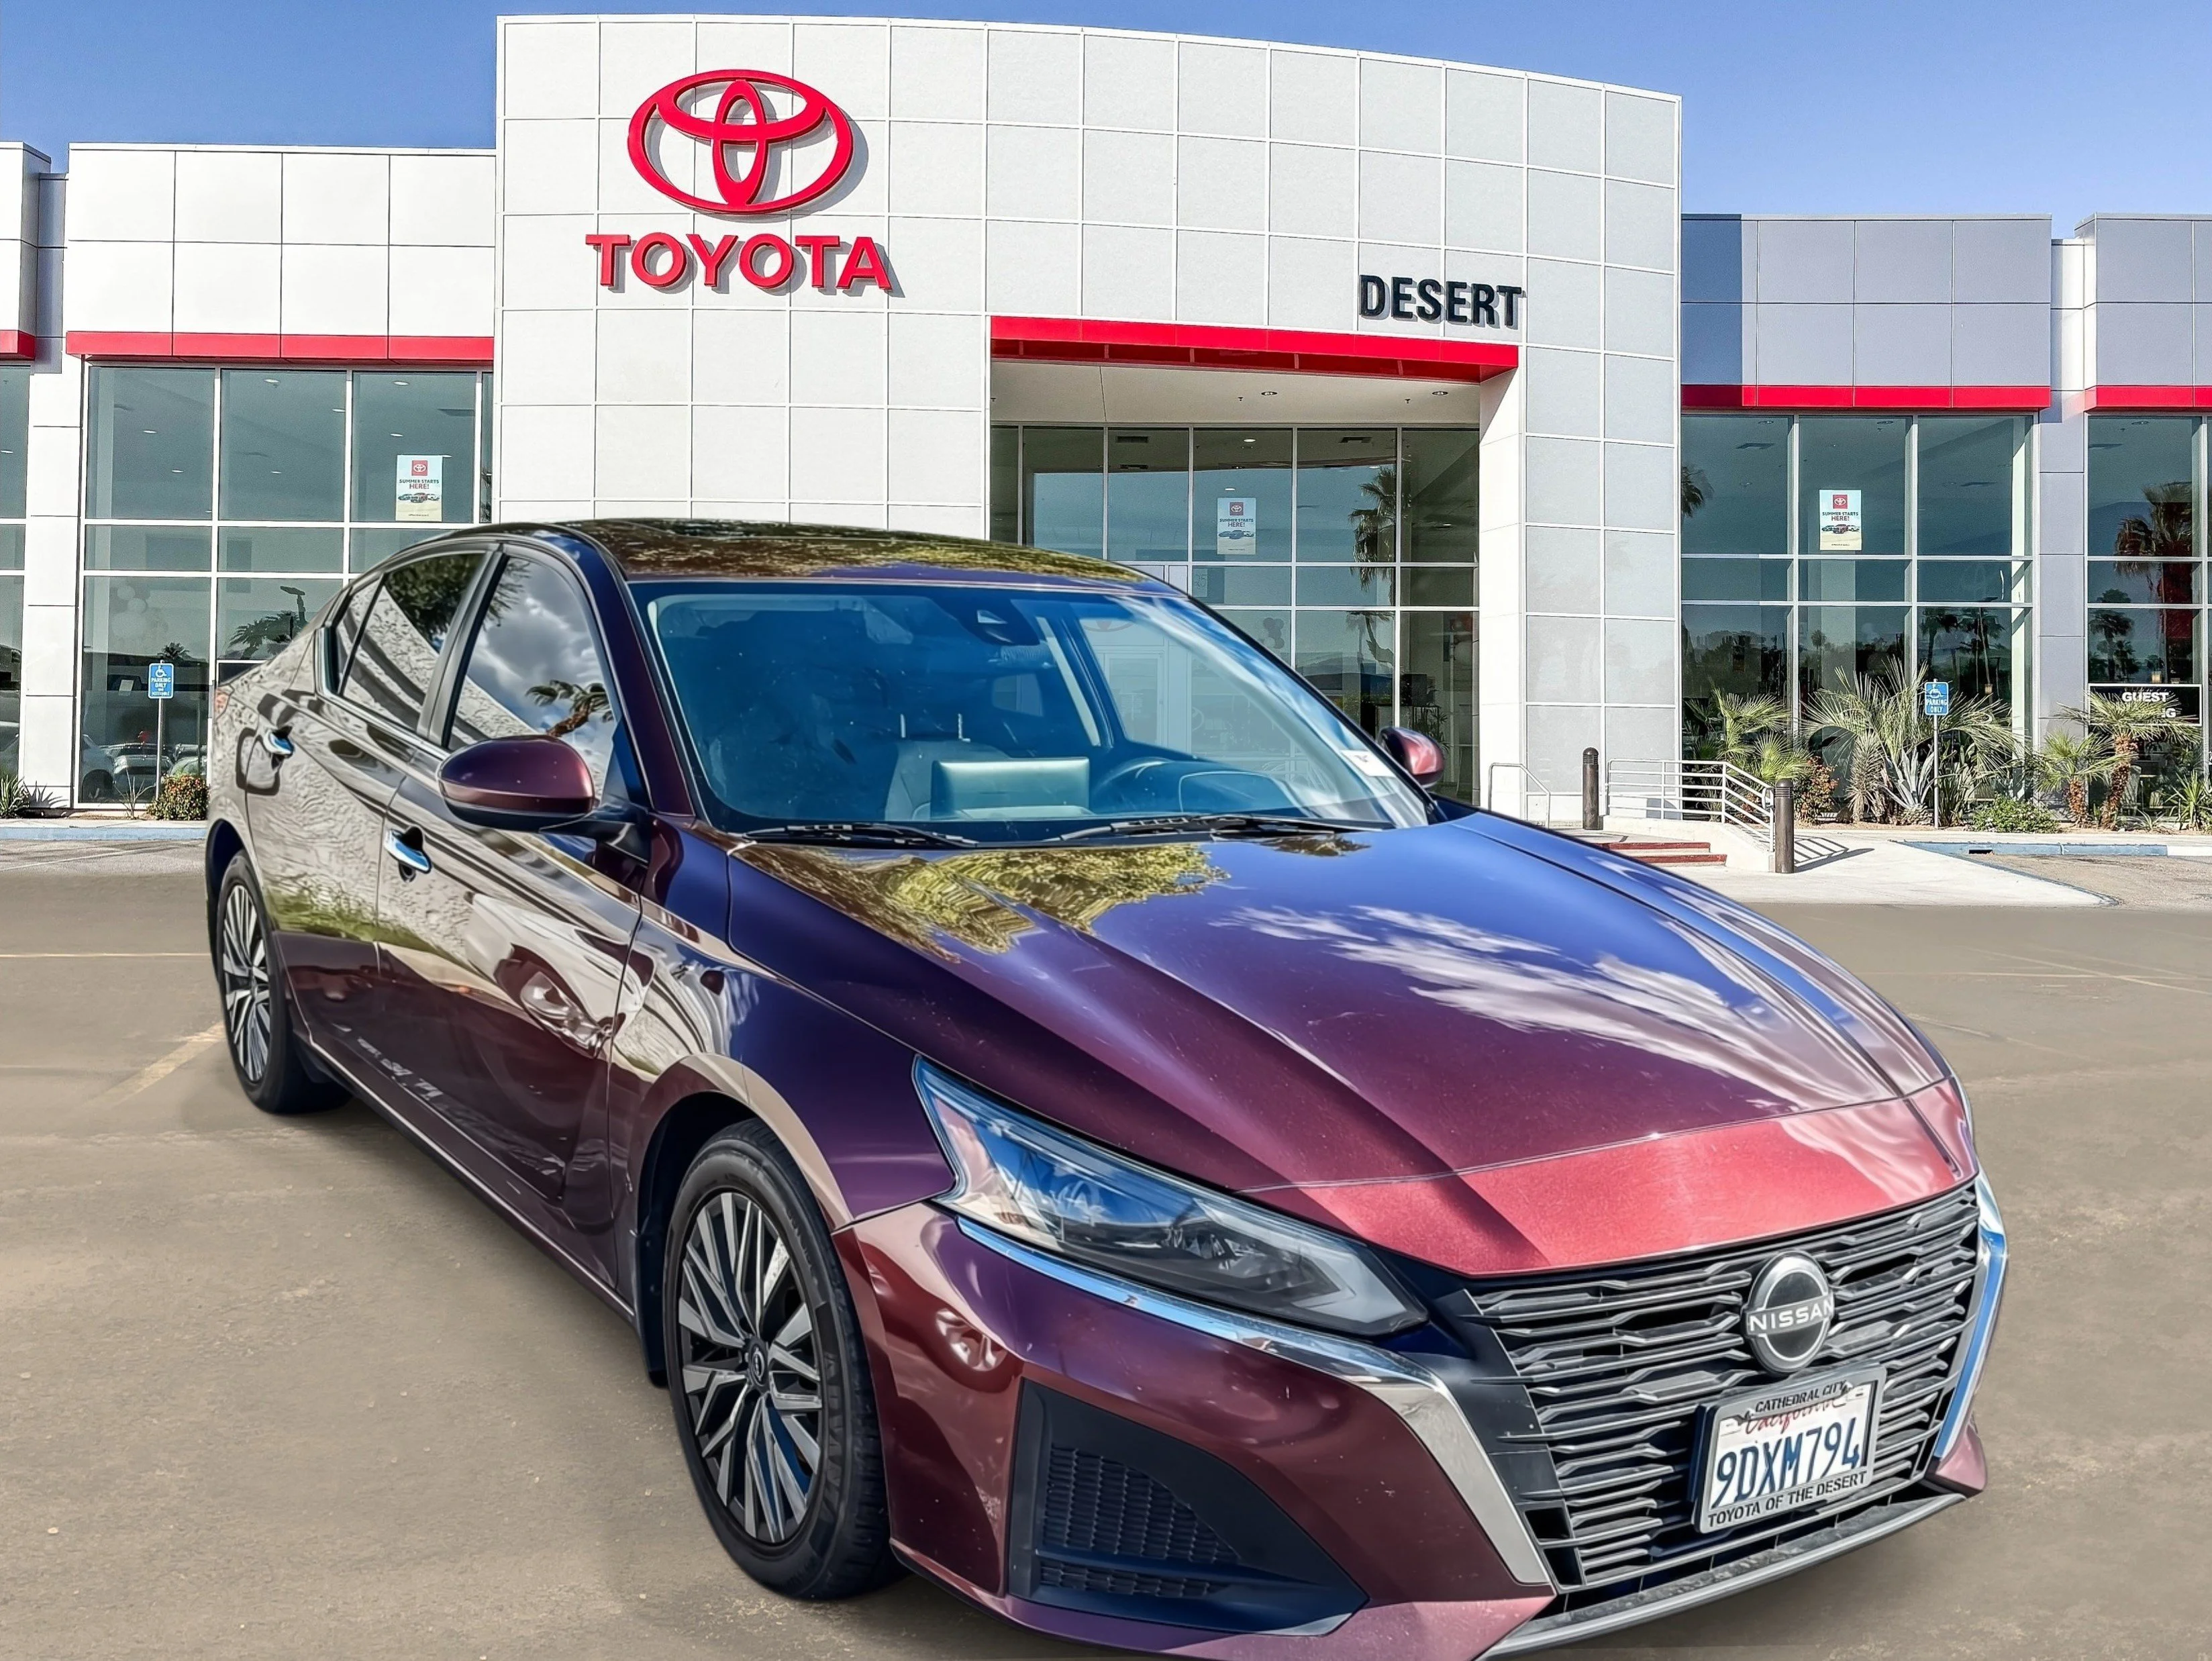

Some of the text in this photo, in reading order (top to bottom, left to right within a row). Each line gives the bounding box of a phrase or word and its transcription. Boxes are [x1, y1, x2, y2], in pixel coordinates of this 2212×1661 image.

[585, 232, 893, 291] TOYOTA
[1359, 274, 1522, 327] DESERT
[2121, 691, 2169, 702] GUEST
[1750, 1298, 1833, 1331] NISSAN
[1755, 1380, 1847, 1413] CATHEDRAL CITY
[1711, 1417, 1860, 1509] 9DXM794
[1708, 1471, 1867, 1527] TOYOTA OF THE DESERT
